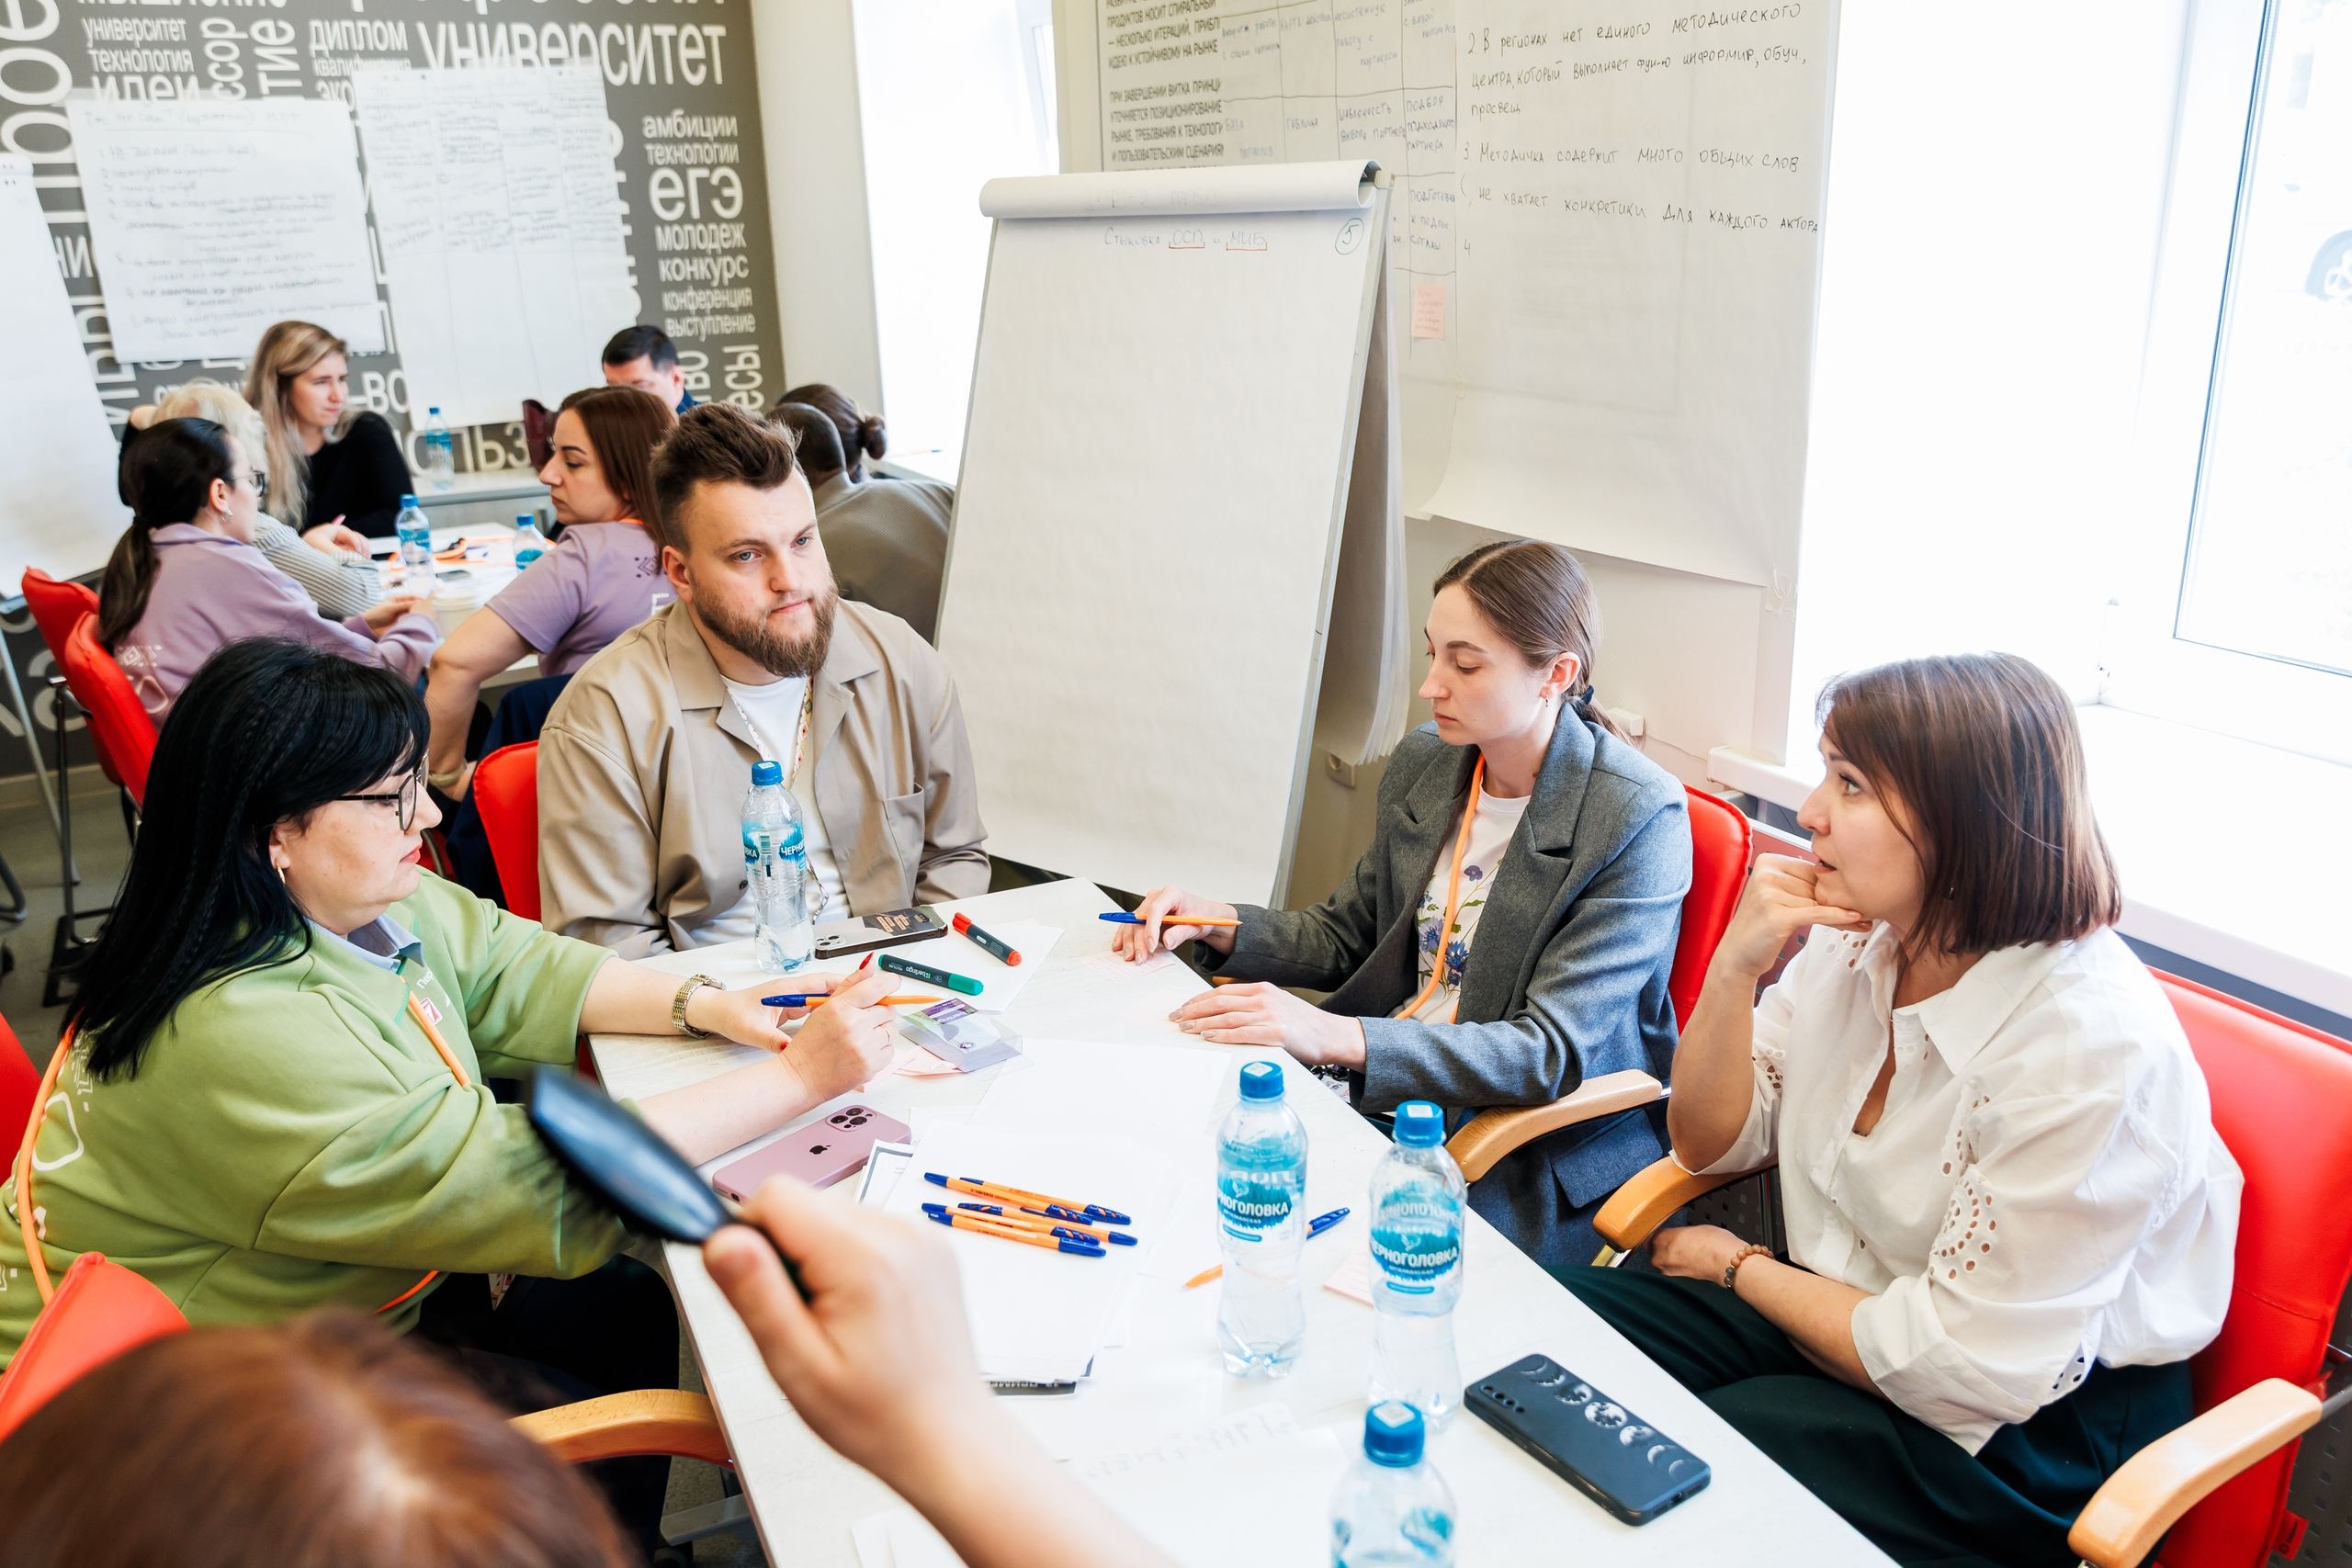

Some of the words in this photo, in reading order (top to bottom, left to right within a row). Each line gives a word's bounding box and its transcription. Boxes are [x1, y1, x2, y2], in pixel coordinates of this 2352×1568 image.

[1107, 10, 1144, 28] ПРОДУКТОВ
[1145, 6, 1166, 21] НОСИТ
[82, 17, 187, 48] университет
[308, 18, 409, 58] диплом
[1116, 29, 1153, 47] НЕСКОЛЬКО
[87, 49, 195, 73] технология
[1108, 55, 1127, 69] ИДЕЮ
[1134, 46, 1181, 65] УСТОЙЧИВОМУ
[1182, 44, 1192, 57] НА
[1193, 39, 1218, 56] РЫНКЕ
[1110, 91, 1123, 104] ПРИ
[1124, 85, 1167, 102] ЗАВЕРШЕНИИ
[1168, 83, 1190, 97] ВИТКА
[642, 109, 738, 139] амбиции
[1110, 107, 1148, 124] УТОЧНЯЕТСЯ
[1149, 99, 1223, 121] ПОЗИЦИОНИРОВАНИЕ
[1135, 126, 1177, 141] ТРЕБОВАНИЯ
[1178, 126, 1183, 138] К
[645, 142, 740, 166] технологии
[1118, 146, 1184, 163] ПОЛЬЗОВАТЕЛЬСКИМ
[653, 221, 748, 255] молодеж
[657, 254, 750, 288] конкурс
[662, 284, 753, 316] конференция
[664, 312, 756, 343] выступление
[905, 965, 926, 979] berlingo
